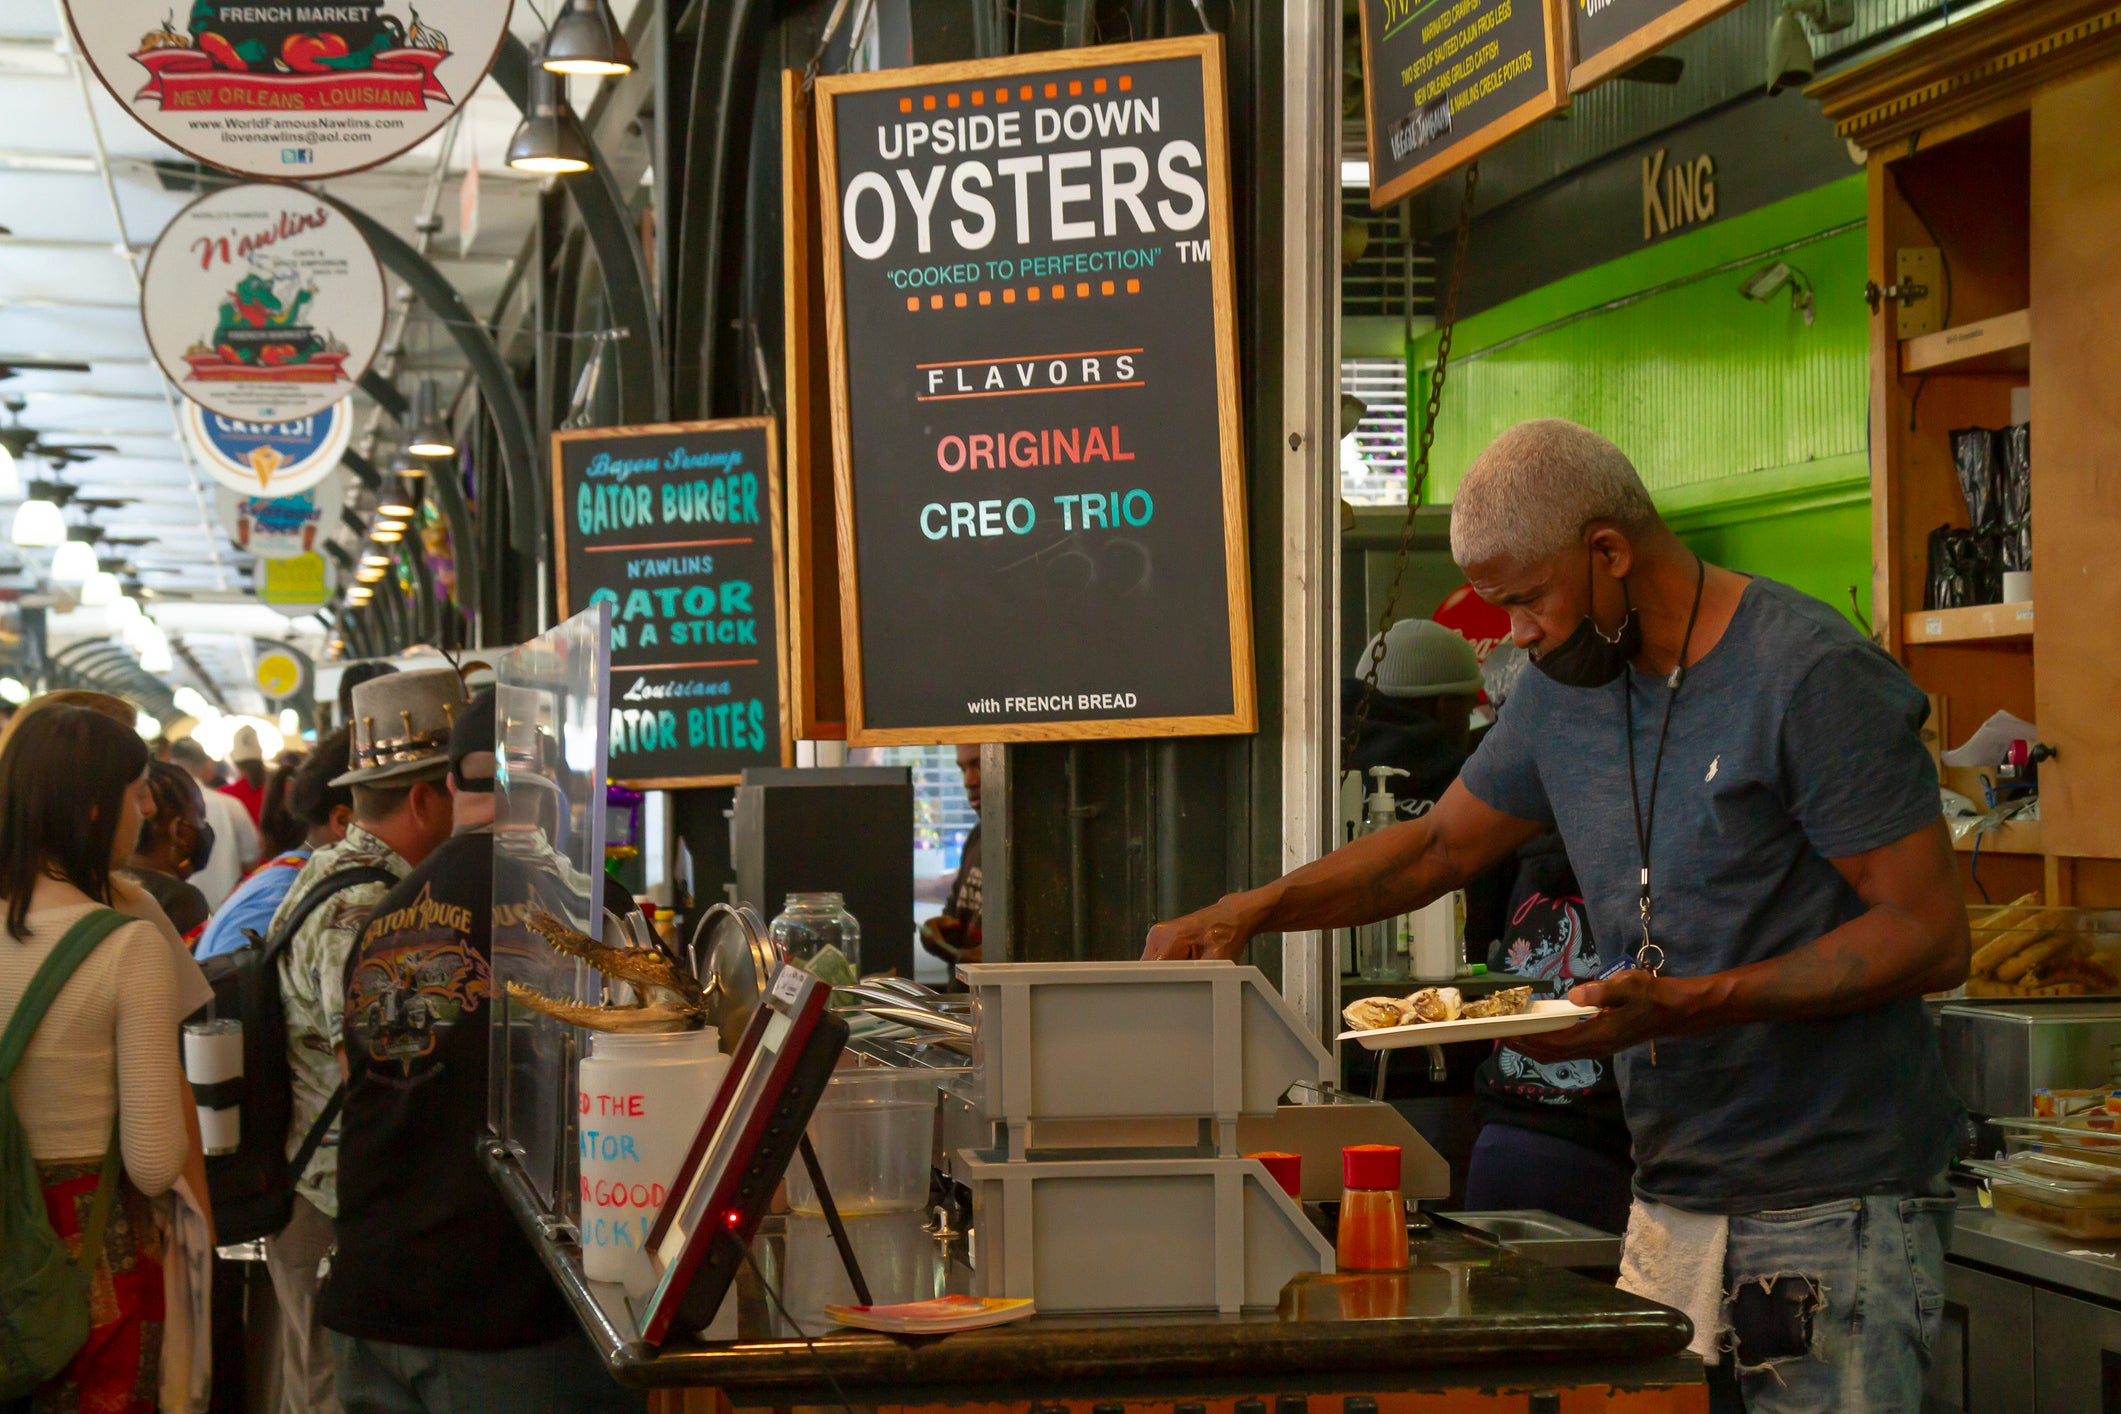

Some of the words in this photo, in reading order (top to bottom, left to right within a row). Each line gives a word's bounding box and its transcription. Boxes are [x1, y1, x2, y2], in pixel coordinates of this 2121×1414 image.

[219, 6, 292, 23] FRENCH
[296, 6, 370, 23] MARKET
[1401, 65, 1413, 87] TWO
[1413, 55, 1427, 80] SETS
[1426, 50, 1434, 71] OF
[1459, 21, 1478, 49] CAJUN
[1478, 10, 1495, 35] FROG
[1495, 0, 1512, 26] LEGS
[1414, 85, 1427, 107] NEW
[1426, 70, 1451, 100] ORLEANS
[1451, 54, 1474, 84] GRILLED
[1474, 38, 1499, 70] CATFISH
[1479, 66, 1504, 98] CREOLE
[1503, 49, 1533, 83] POTATOS
[172, 87, 213, 107] NEW
[218, 85, 305, 110] ORLEANS
[318, 86, 418, 108] LOUISIANA
[188, 117, 404, 130] www.WorldFamousNawlins.com
[220, 130, 372, 144] ilovenawlins@aol.com
[878, 110, 1022, 160] UPSIDE
[1034, 96, 1160, 145] DOWN
[843, 139, 1206, 260] OYSTERS
[887, 262, 980, 289] "COOKED
[986, 259, 1014, 280] TO
[1020, 247, 1162, 278] PERFECTION"
[1175, 239, 1211, 264] TM
[928, 355, 1136, 394] FLAVORS
[586, 452, 660, 482] Bayou
[664, 446, 744, 474] Swamp
[937, 425, 1136, 472] ORIGINAL
[577, 481, 654, 536] GATOR
[661, 470, 760, 525] BURGER
[920, 497, 1036, 540] CREO
[1053, 488, 1154, 532] TRIO
[626, 554, 714, 580] N'AWLINS
[611, 624, 629, 651] N
[638, 622, 659, 649] A
[669, 618, 758, 646] STICK
[623, 676, 732, 702] Louisiana
[967, 698, 1001, 714] with
[1004, 695, 1073, 713] FRENCH
[1078, 692, 1137, 711] BREAD
[609, 707, 678, 759] ATOR
[686, 697, 767, 753] BITES
[419, 897, 472, 934] ROUGE
[596, 1095, 645, 1117] THE
[580, 1130, 640, 1163] ATOR
[595, 1179, 666, 1208] GOOD
